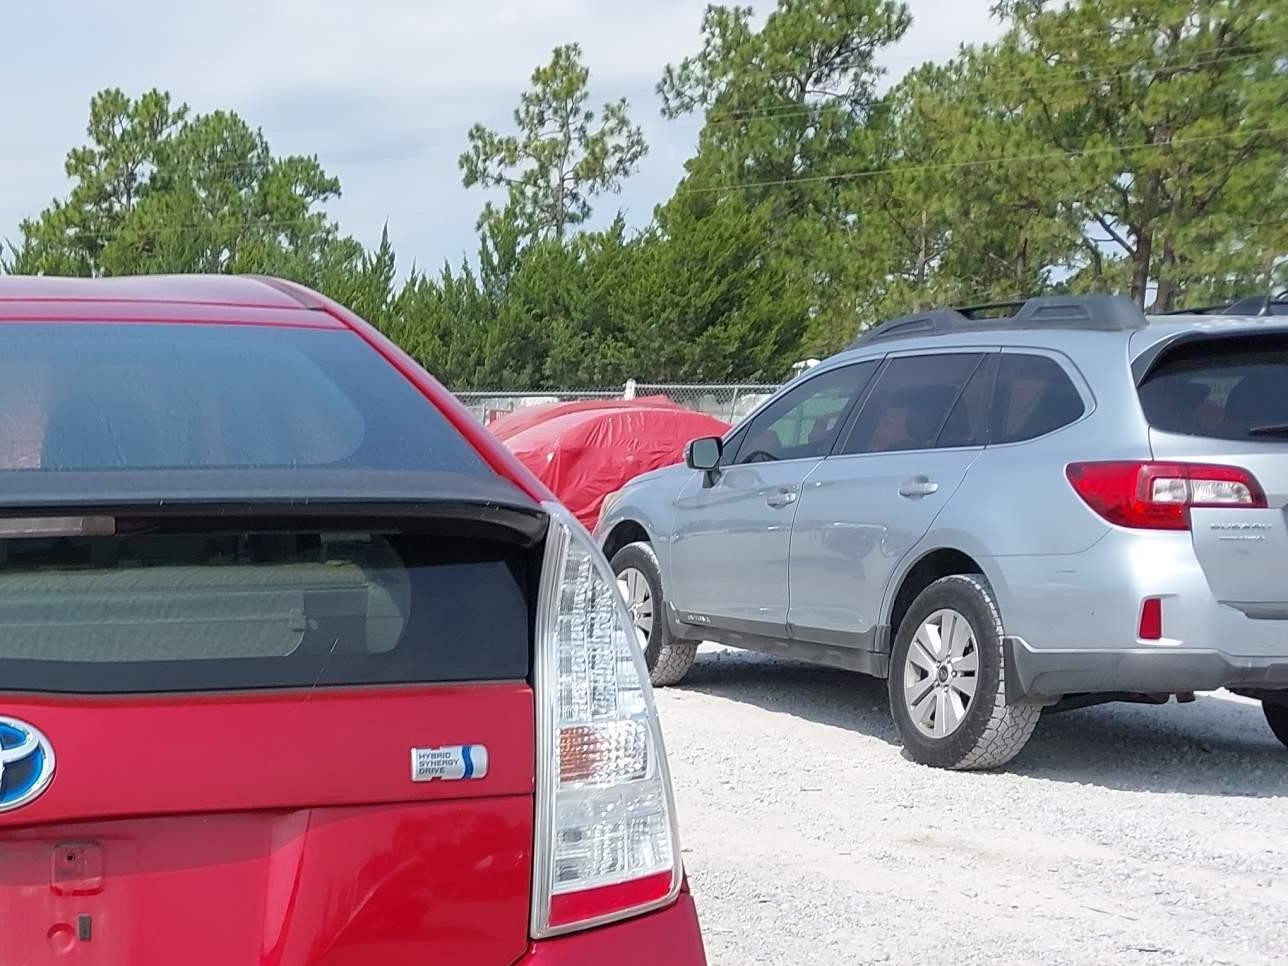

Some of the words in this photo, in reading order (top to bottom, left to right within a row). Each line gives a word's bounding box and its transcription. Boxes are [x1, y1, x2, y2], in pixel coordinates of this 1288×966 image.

[418, 752, 451, 760] HYBRID
[419, 759, 459, 767] SYNERGY
[419, 767, 445, 775] DRIVE
